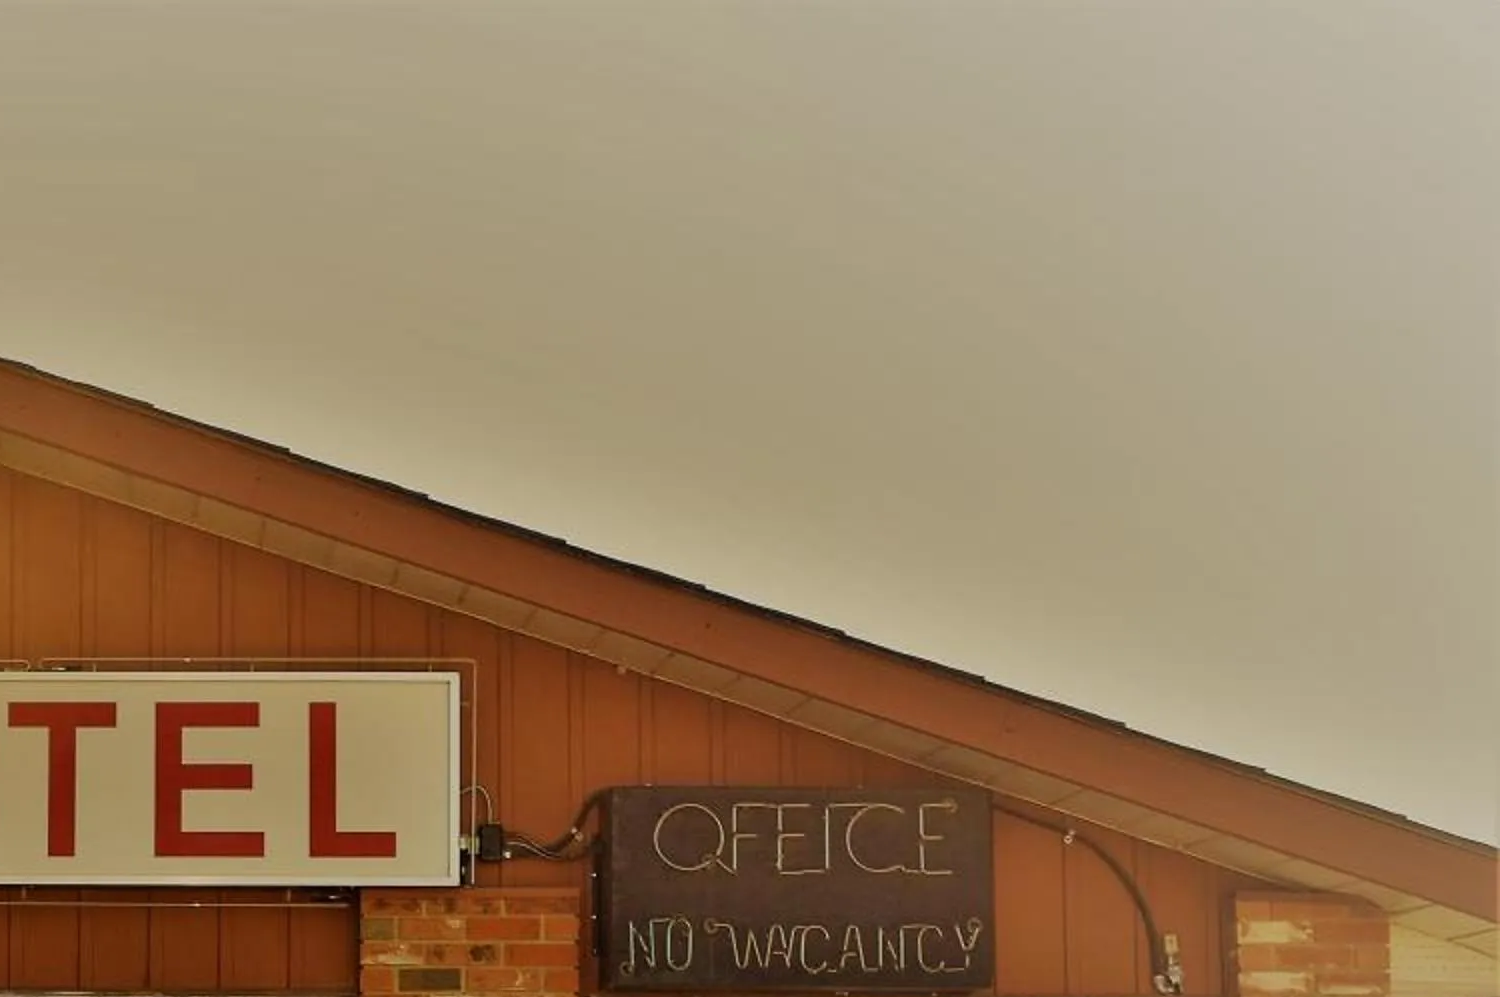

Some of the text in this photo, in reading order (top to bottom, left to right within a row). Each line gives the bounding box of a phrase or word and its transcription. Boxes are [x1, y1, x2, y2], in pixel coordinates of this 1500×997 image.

[653, 803, 957, 876] OFFICE
[626, 917, 982, 974] NO VACANCY
